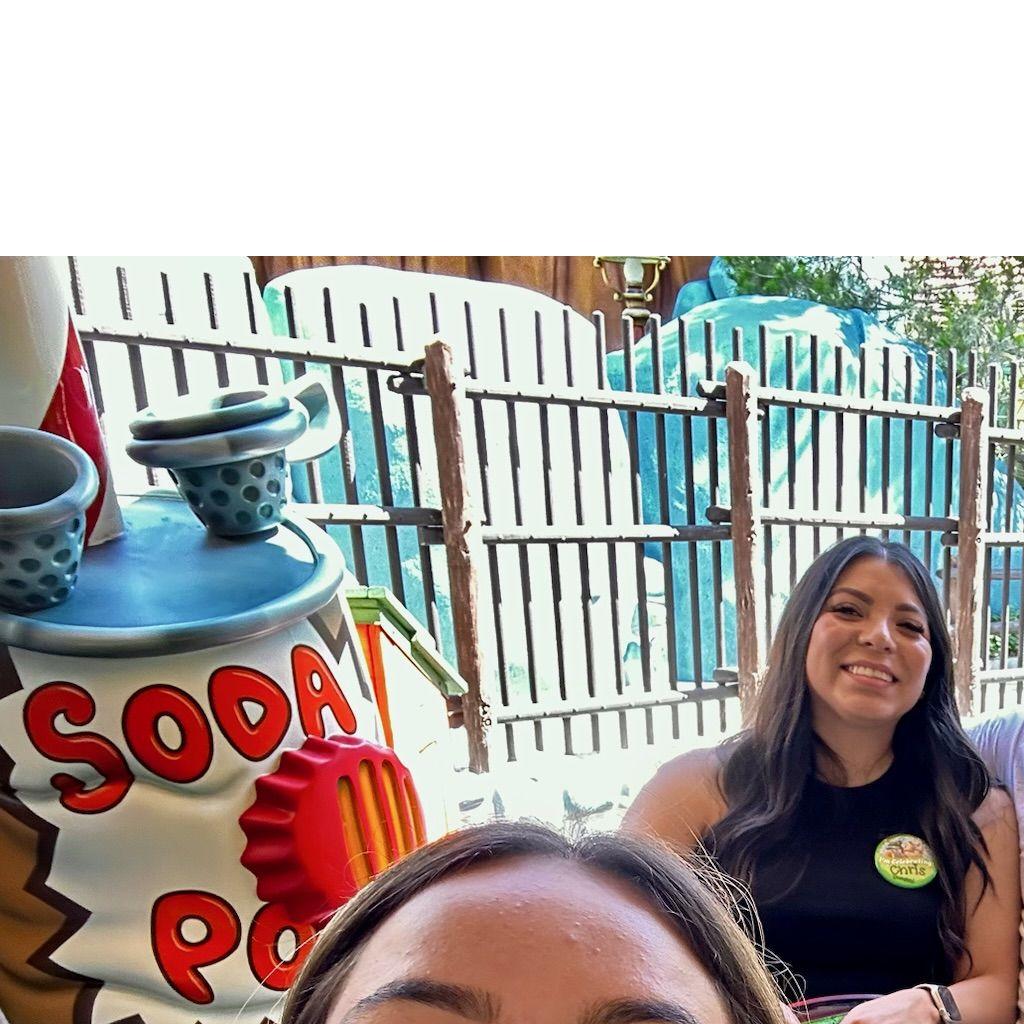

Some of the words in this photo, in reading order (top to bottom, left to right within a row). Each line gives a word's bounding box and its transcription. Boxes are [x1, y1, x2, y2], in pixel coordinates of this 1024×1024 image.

[23, 644, 357, 814] SODA
[890, 863, 926, 876] Chris
[151, 889, 320, 1004] PO
